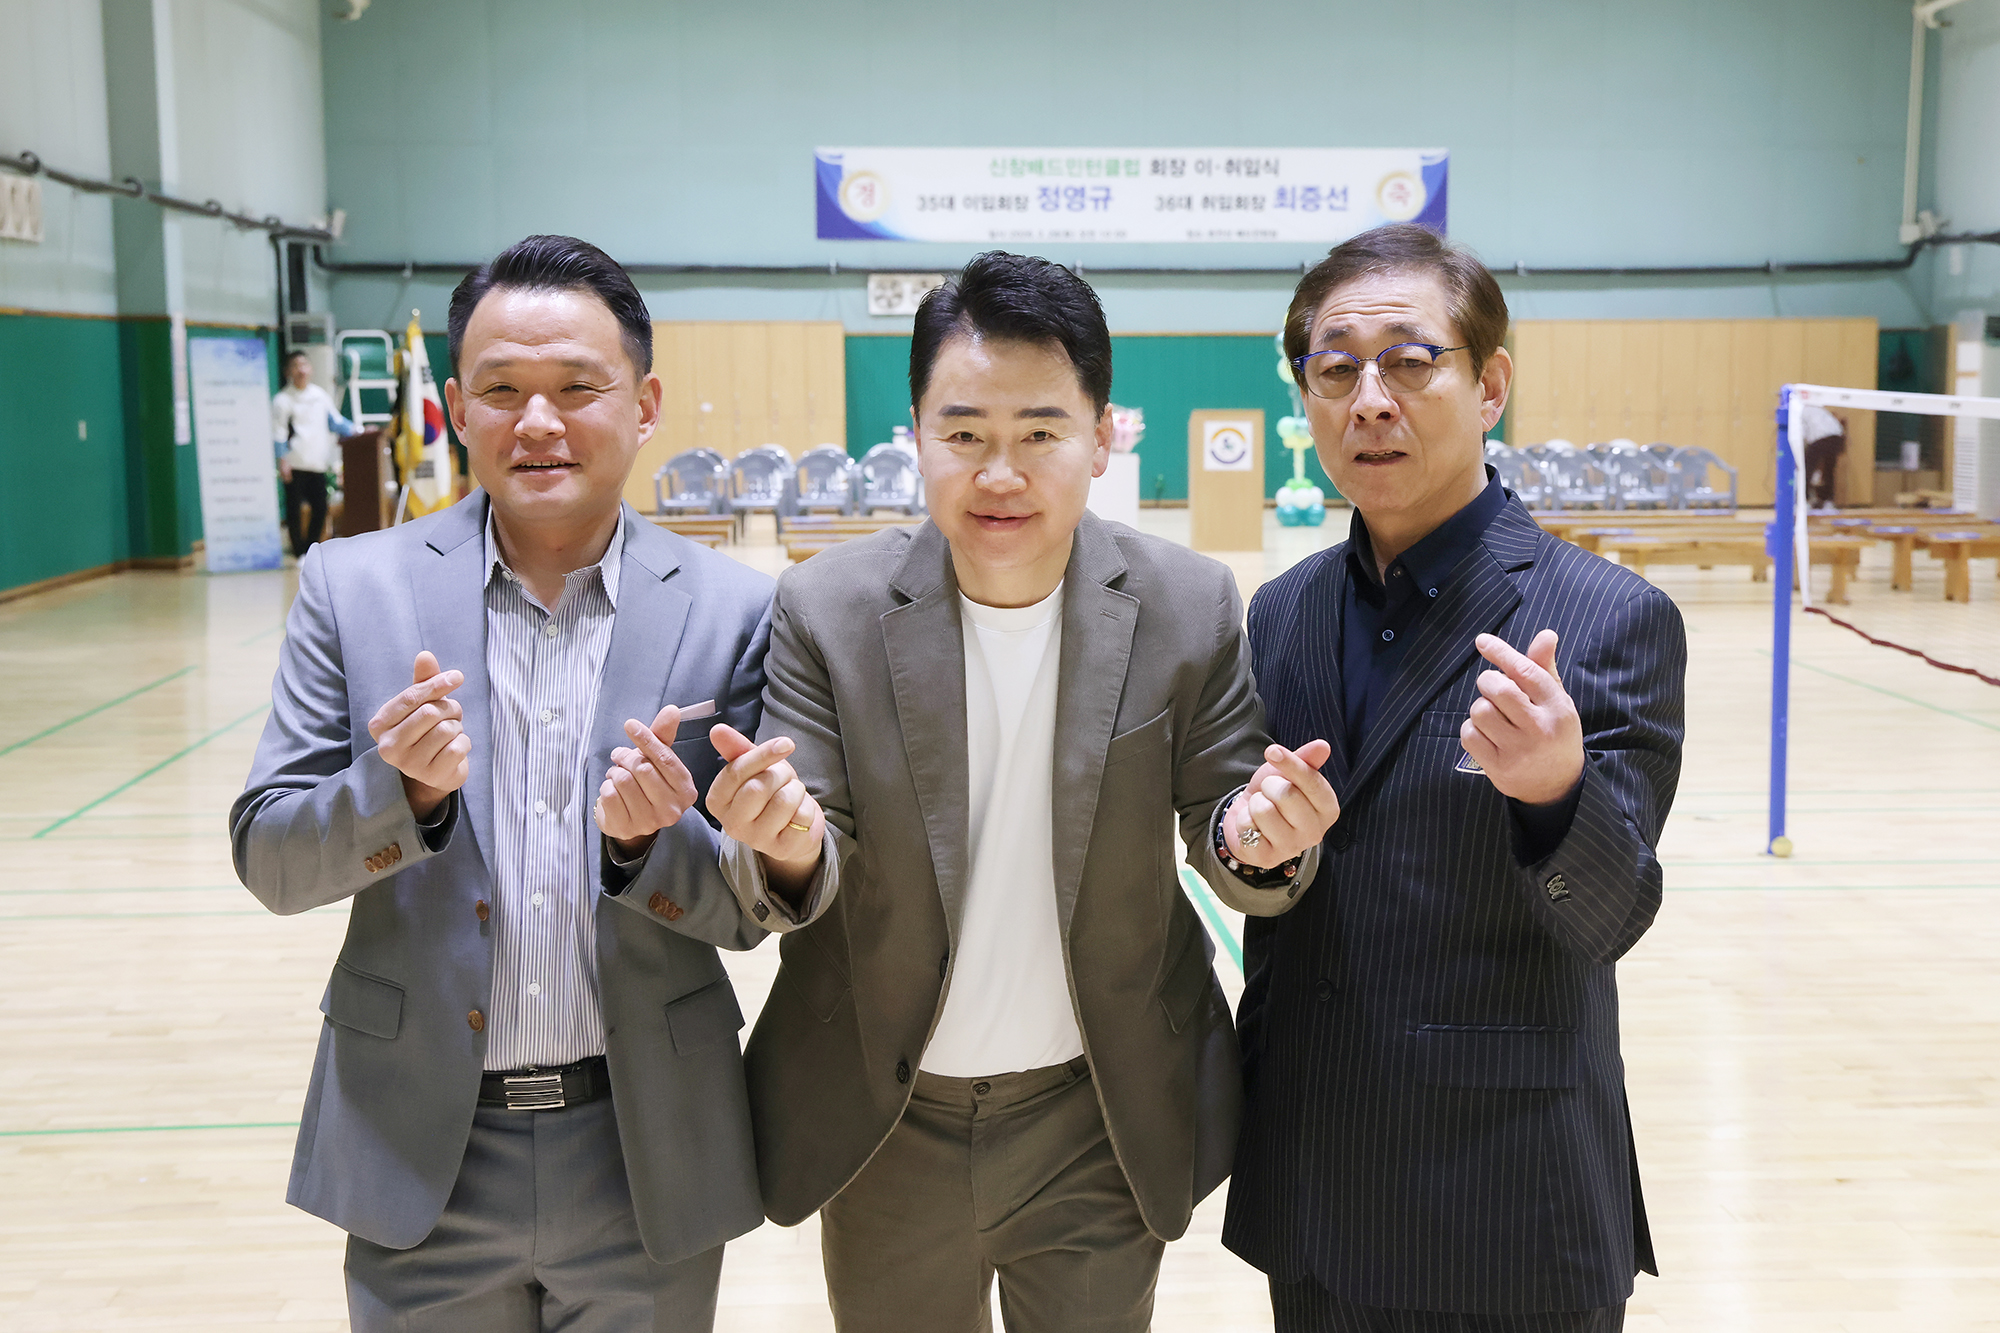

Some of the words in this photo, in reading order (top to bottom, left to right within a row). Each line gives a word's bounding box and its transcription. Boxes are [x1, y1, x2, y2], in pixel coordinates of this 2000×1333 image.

[1150, 158, 1186, 177] 회장
[917, 195, 955, 211] 35대
[962, 195, 1029, 212] 이임회장
[1037, 185, 1112, 212] 정영규
[1154, 195, 1193, 211] 36대
